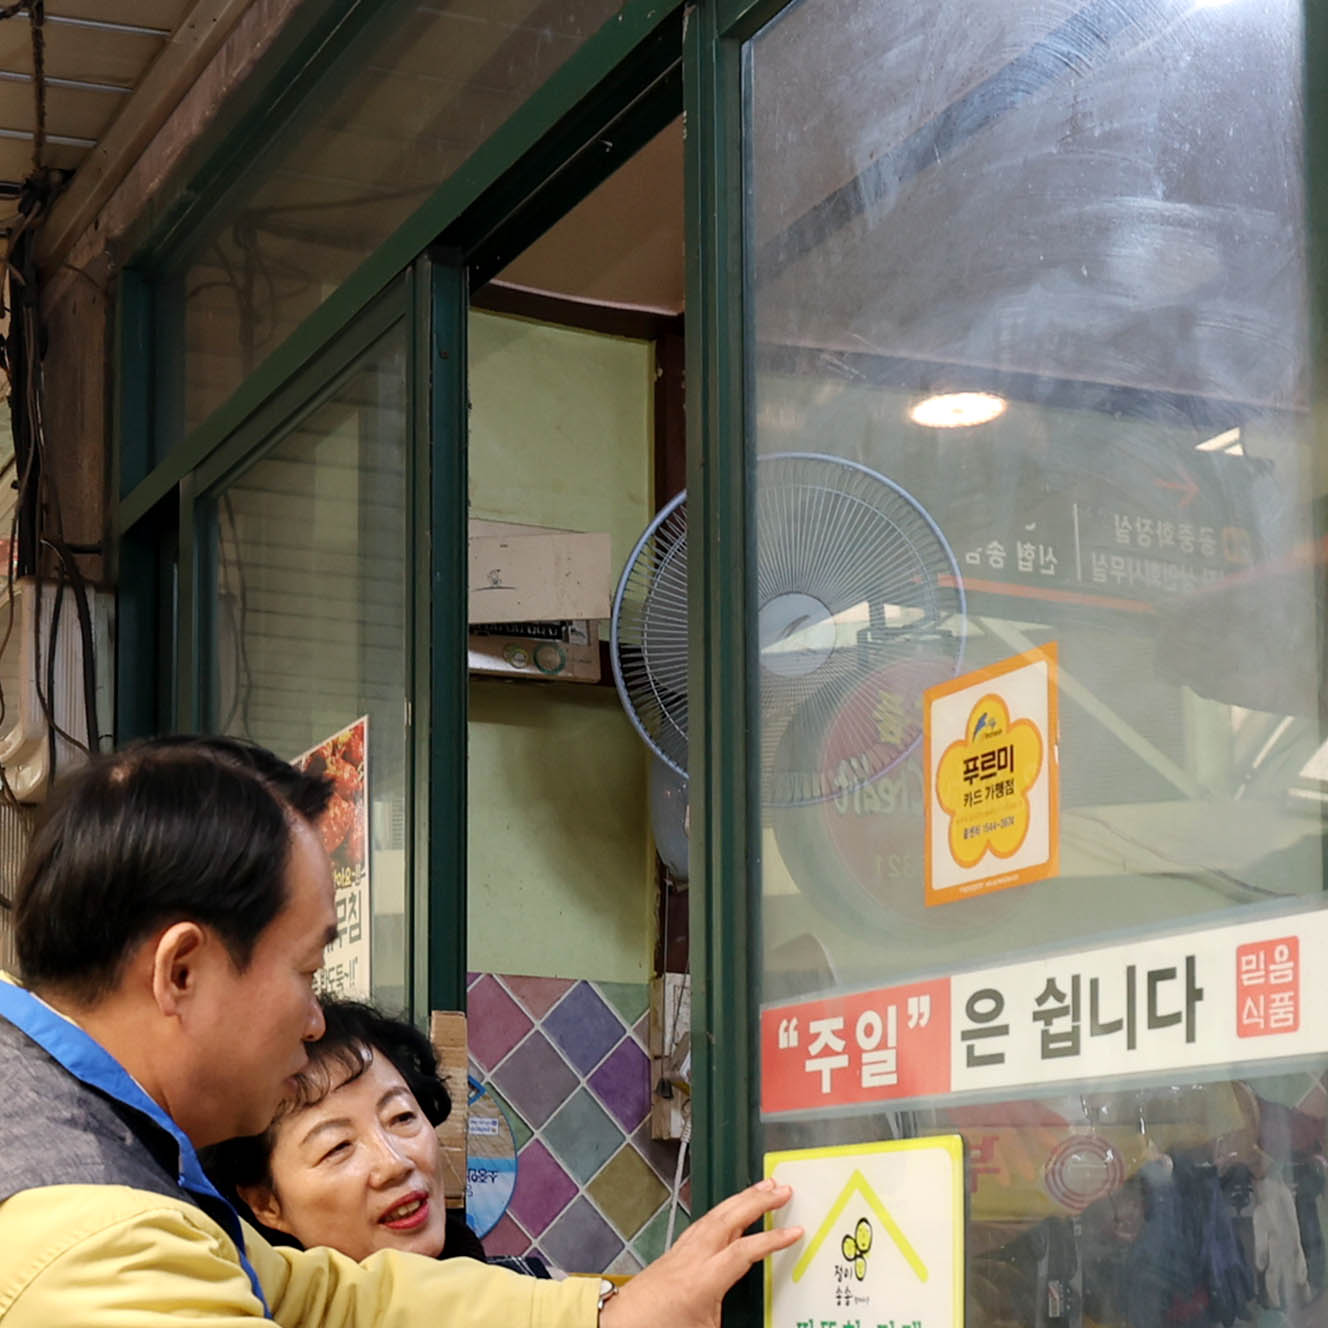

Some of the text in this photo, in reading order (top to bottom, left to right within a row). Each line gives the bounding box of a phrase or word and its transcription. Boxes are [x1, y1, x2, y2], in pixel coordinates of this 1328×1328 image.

[963, 743, 1014, 786] 푸르미
[963, 778, 1014, 808] 카드 가맹점
[1239, 942, 1296, 987] 믿음
[1032, 954, 1204, 1061] 쉽니다
[1240, 991, 1296, 1030] 식품
